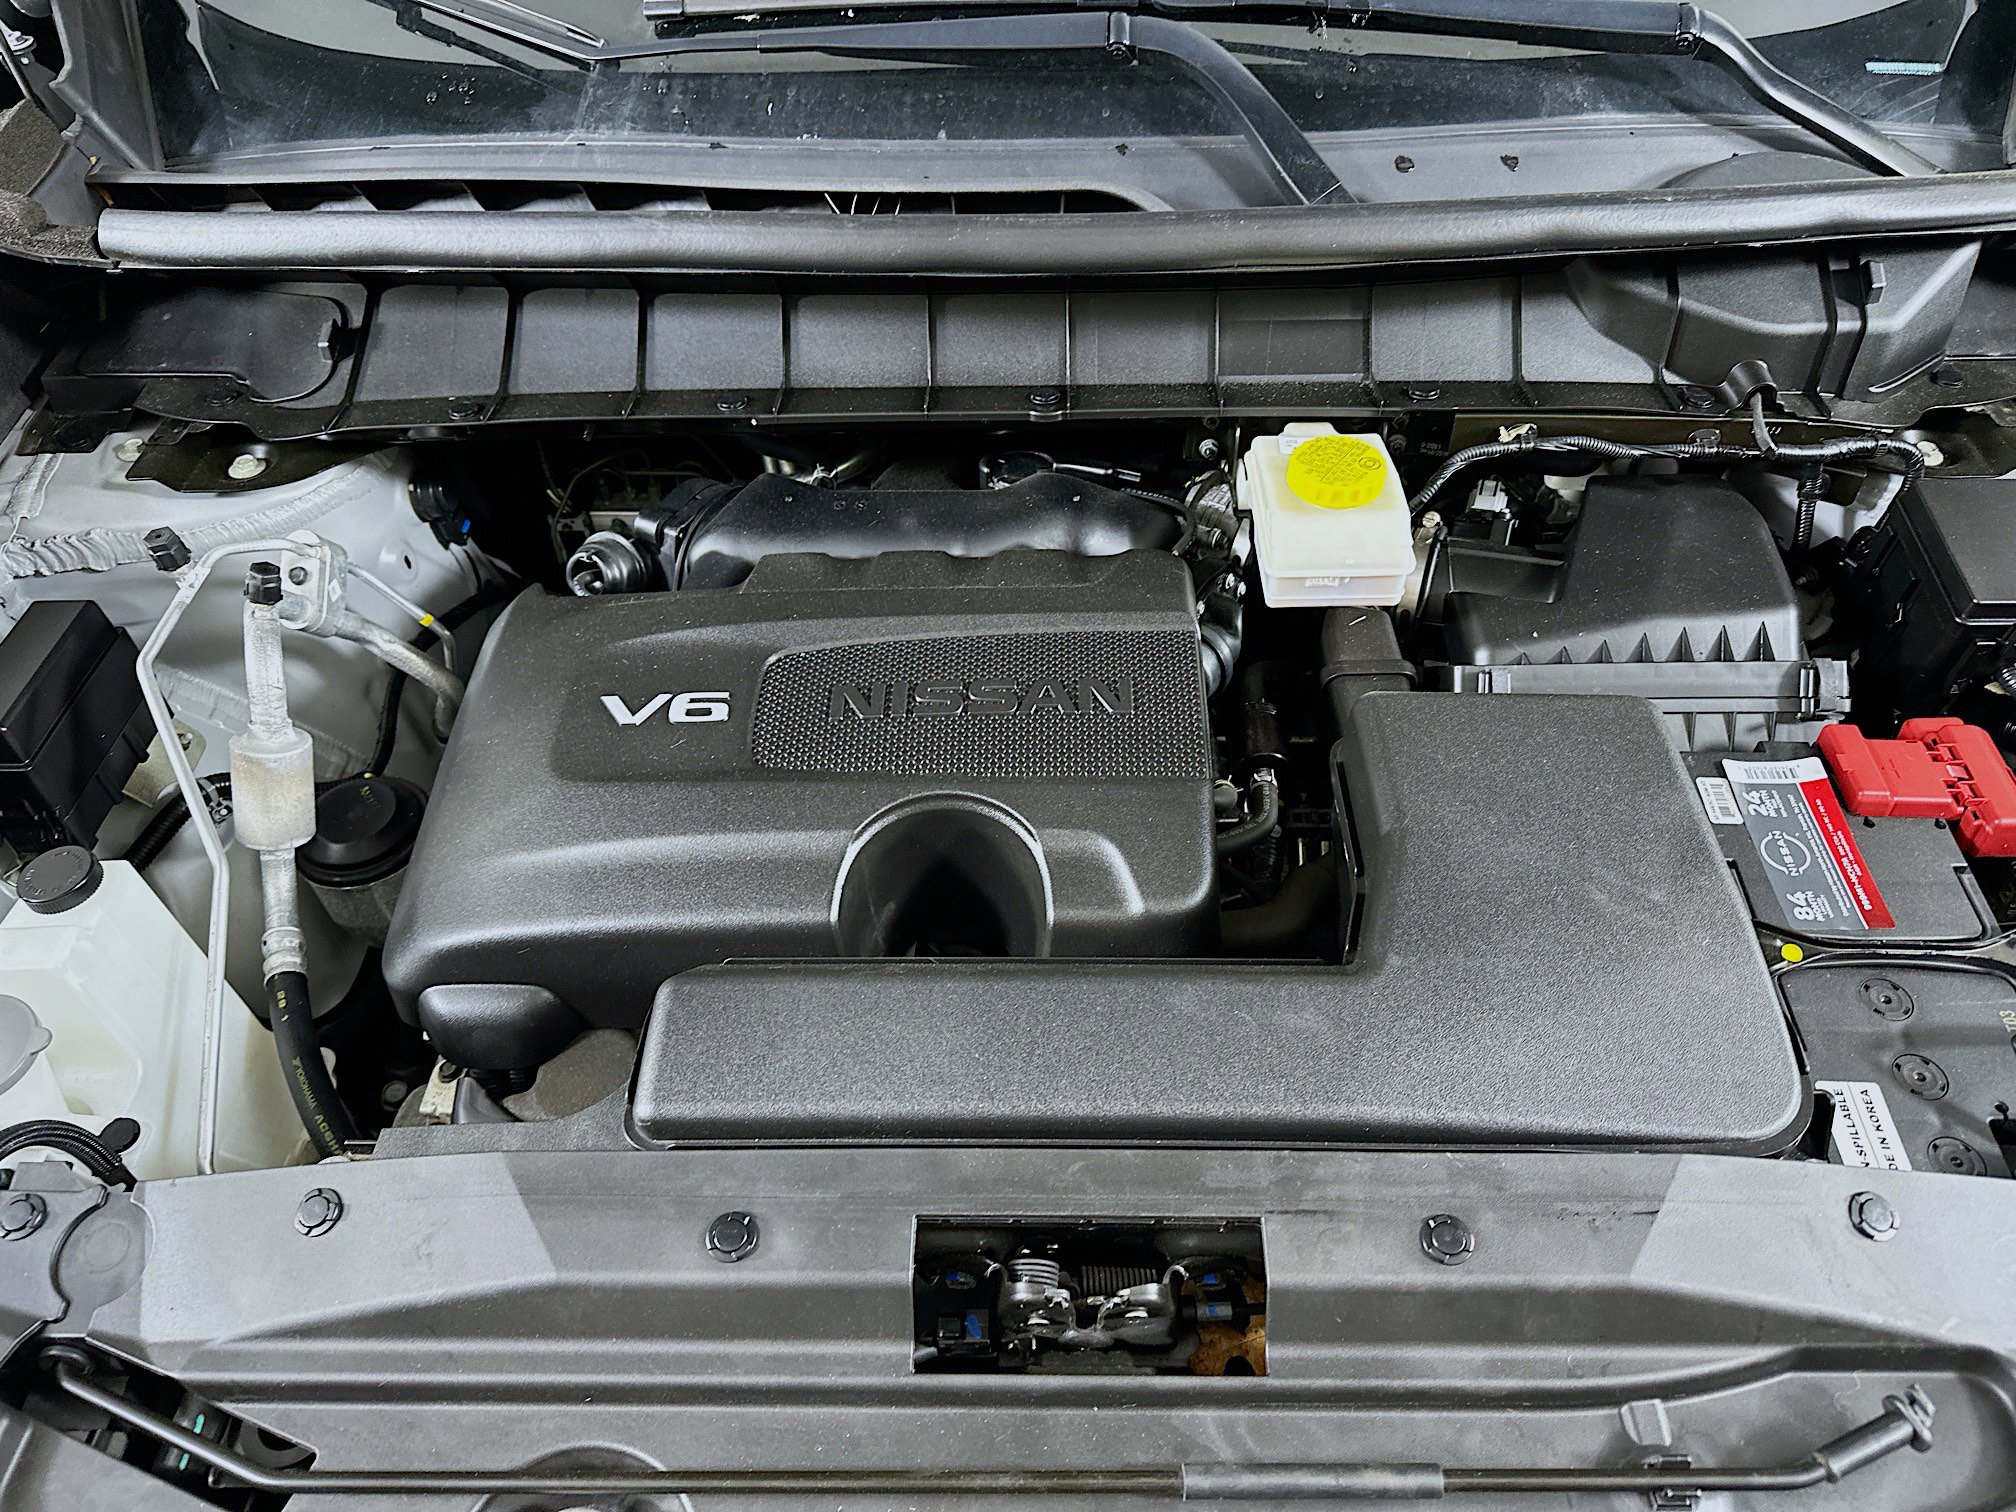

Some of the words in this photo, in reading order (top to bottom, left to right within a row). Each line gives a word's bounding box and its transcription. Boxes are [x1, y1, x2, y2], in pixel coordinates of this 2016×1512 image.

[600, 691, 730, 726] V6
[829, 677, 1133, 721] NISSAN
[1740, 789, 1769, 817] 24
[1758, 790, 1778, 818] MONTH
[1771, 829, 1800, 877] NISSAN
[1786, 890, 1815, 921] 84
[1804, 890, 1826, 922] MONTH
[296, 1066, 318, 1110] YOKOHAMA
[1860, 1089, 1883, 1132] KOREA
[1877, 1136, 1890, 1150] IN
